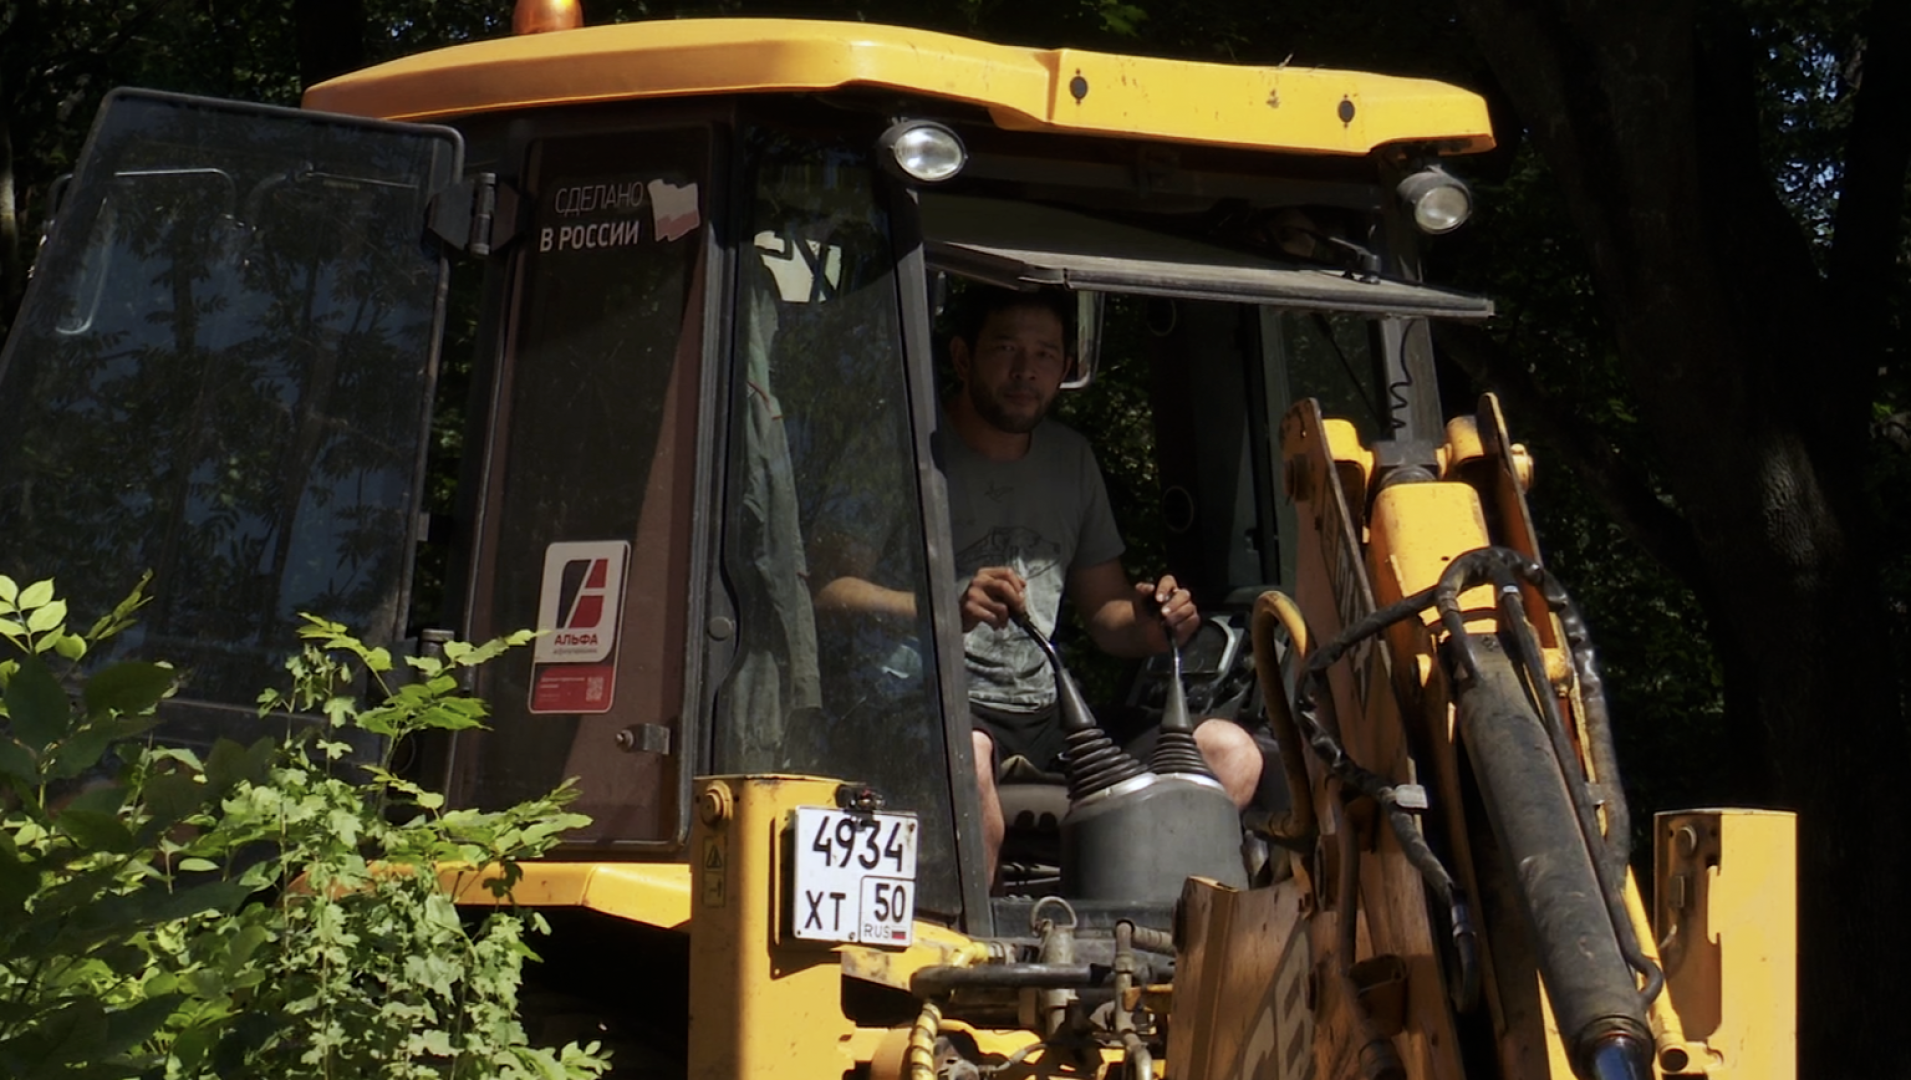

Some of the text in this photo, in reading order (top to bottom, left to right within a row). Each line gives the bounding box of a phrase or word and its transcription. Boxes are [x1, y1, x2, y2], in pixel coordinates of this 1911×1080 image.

[555, 182, 644, 217] СДЕЛАНО
[540, 220, 640, 252] В РОССИИ
[554, 633, 599, 646] АЛЬФА
[812, 816, 903, 873] 4934
[874, 883, 906, 923] 50
[864, 923, 891, 939] RUS
